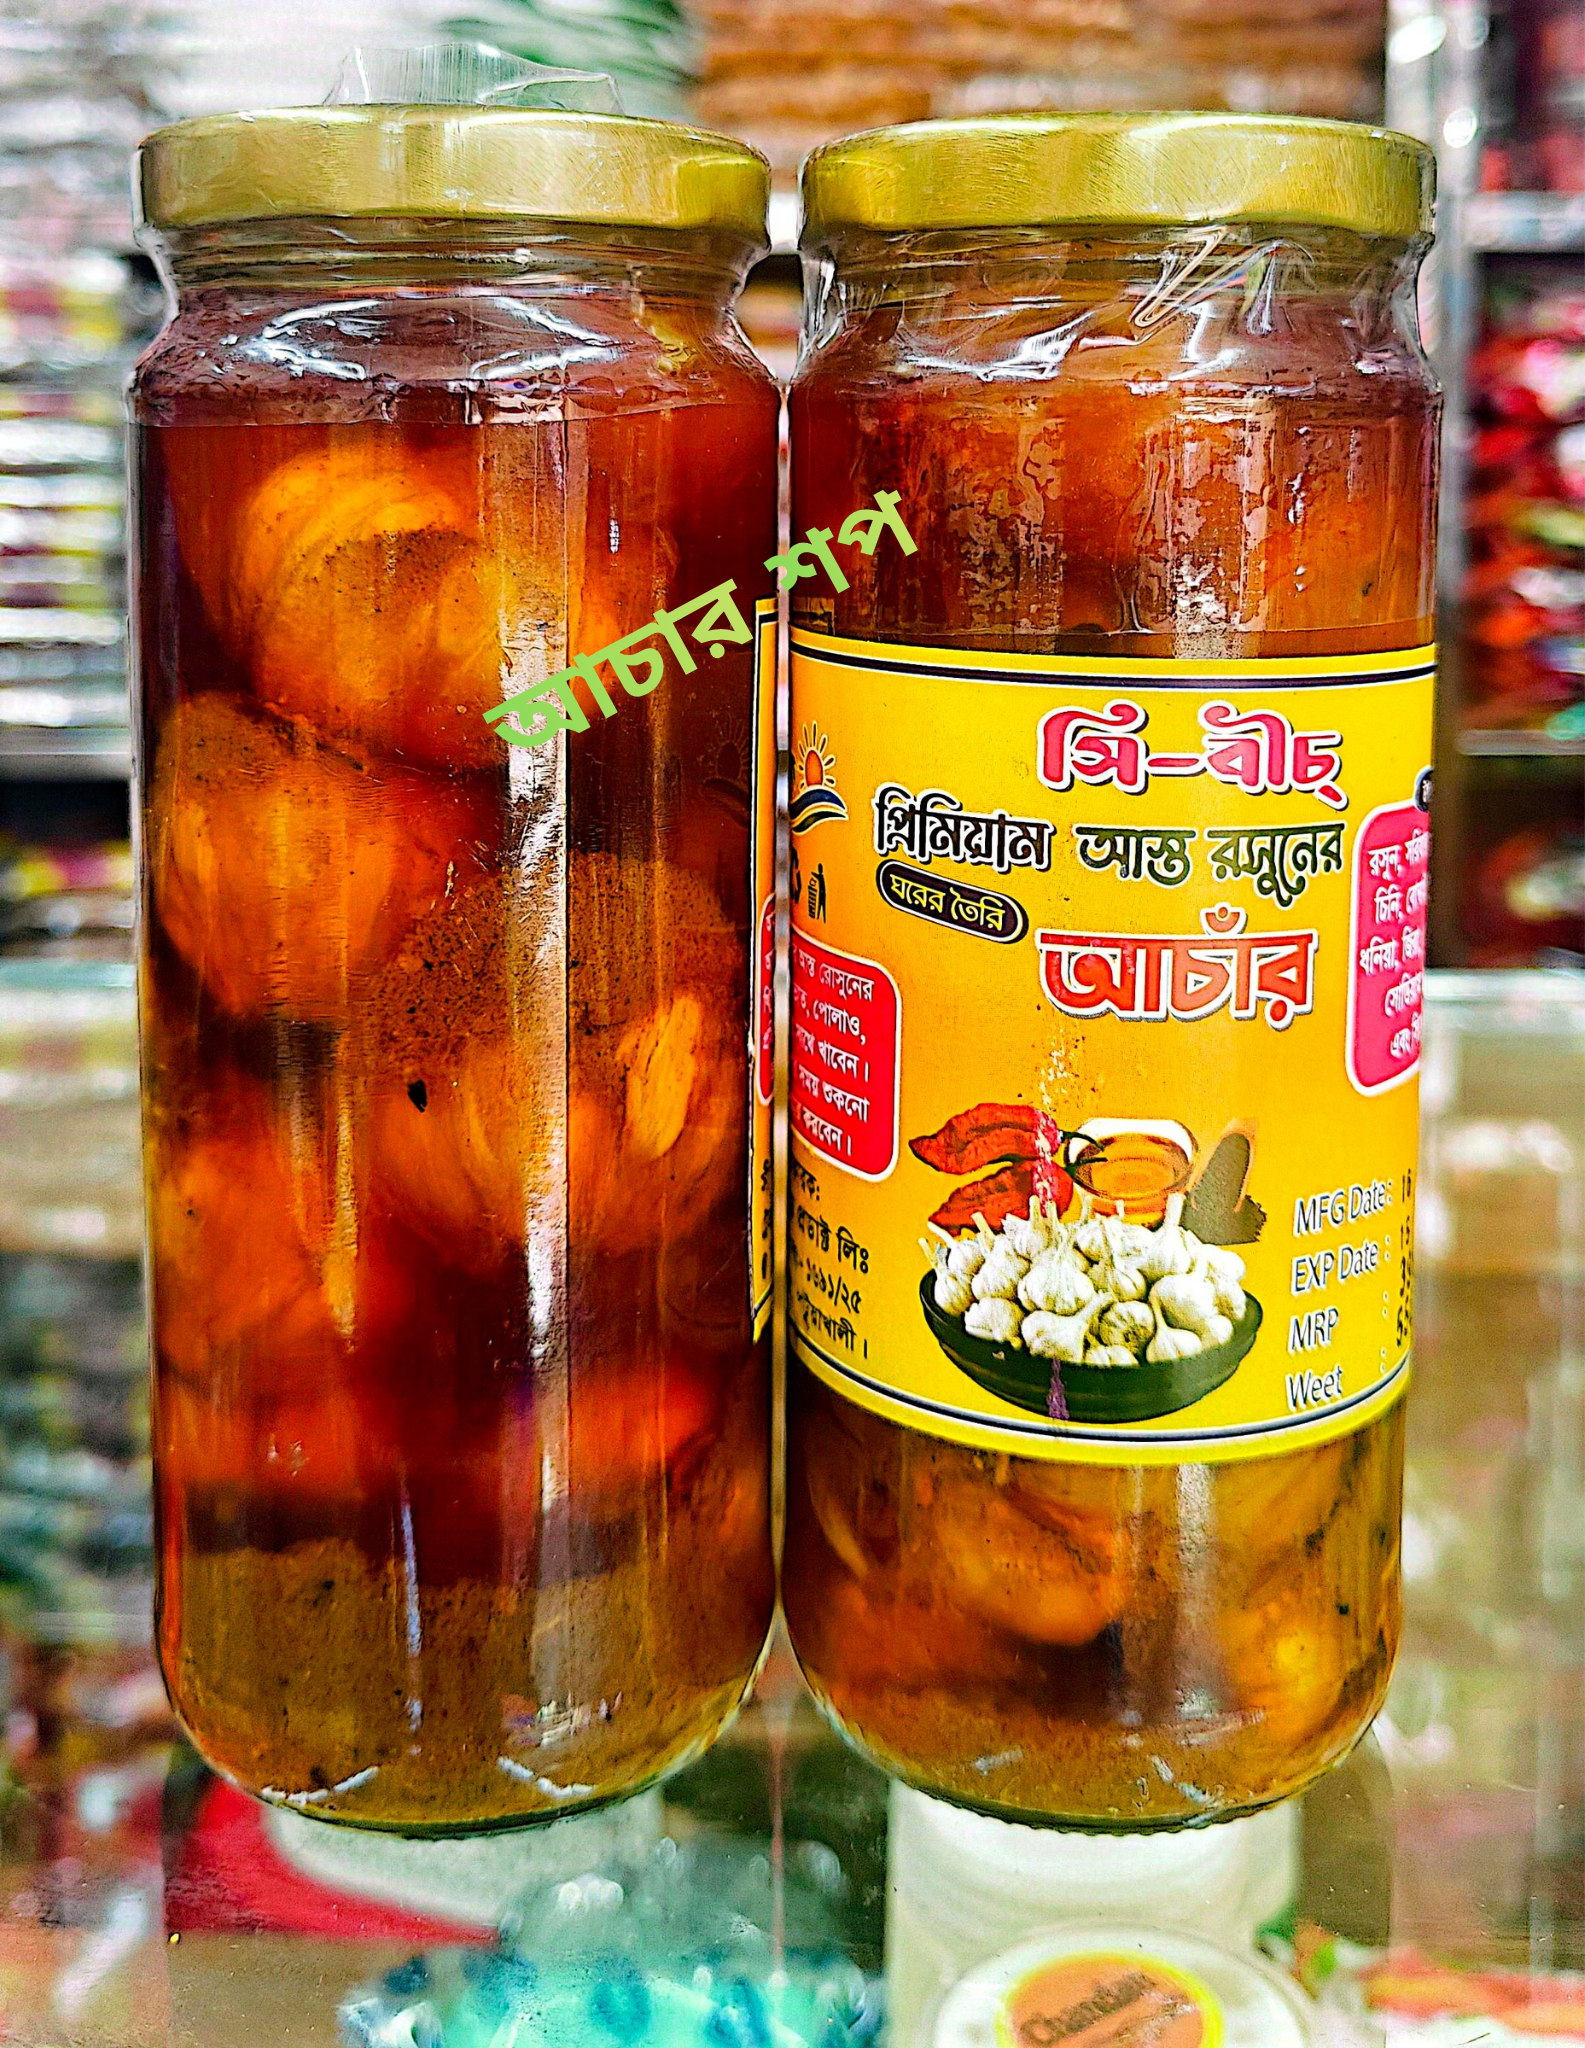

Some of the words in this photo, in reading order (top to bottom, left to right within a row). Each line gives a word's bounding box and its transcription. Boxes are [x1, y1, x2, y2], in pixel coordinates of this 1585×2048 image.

[872, 783, 1055, 873] প্রিমিয়াম
[1074, 826, 1197, 886] আস্ত
[1206, 822, 1346, 907] রসুনের
[890, 873, 945, 913] ঘরের
[949, 886, 1006, 931] তৈরি
[820, 964, 874, 1001] রোসুনের
[1295, 1190, 1345, 1234] MFG
[1294, 1252, 1335, 1292] EXP
[1290, 1308, 1339, 1351] MRP
[1287, 1366, 1342, 1408] Weet
